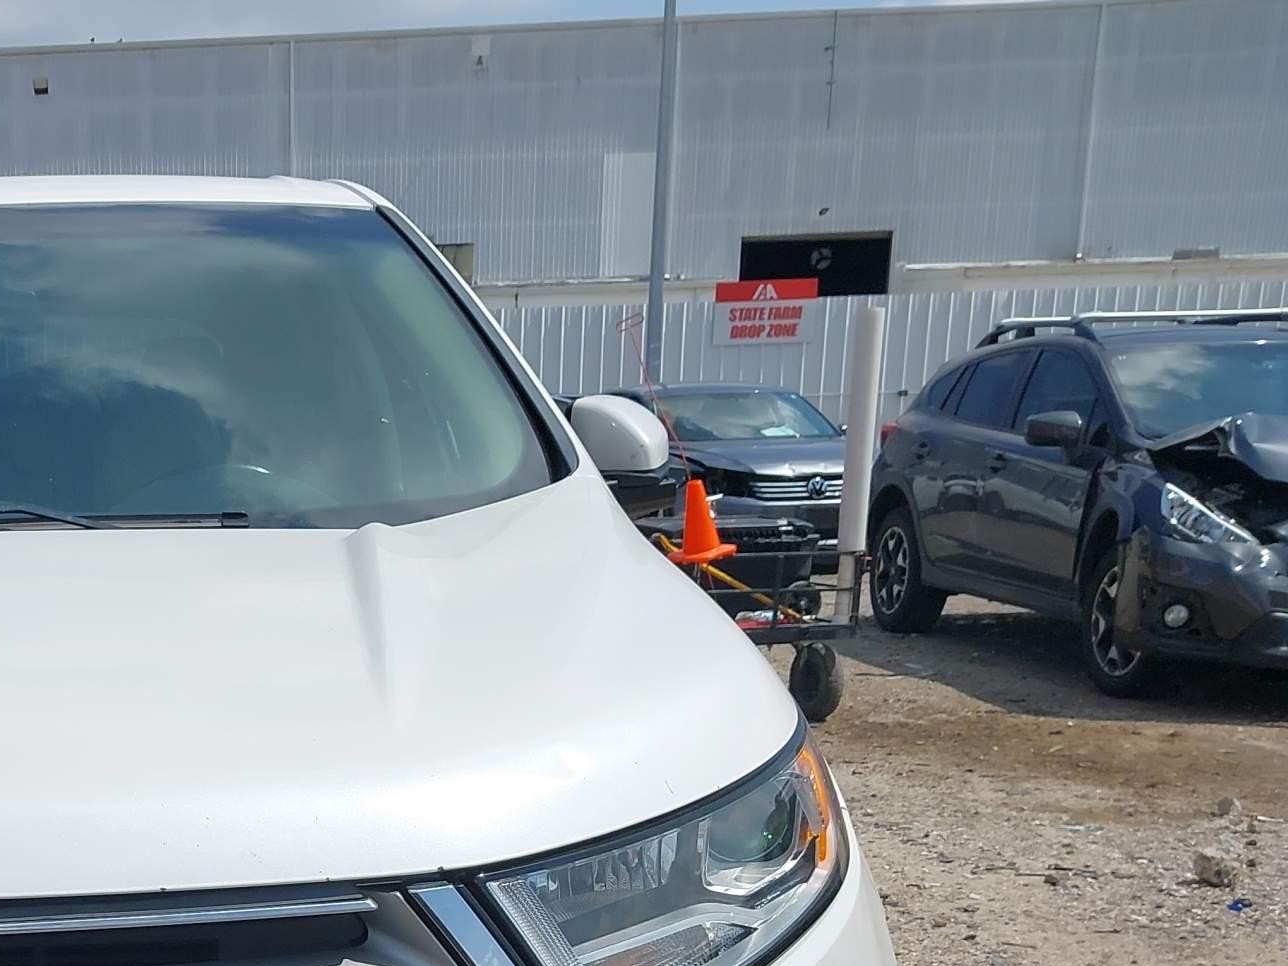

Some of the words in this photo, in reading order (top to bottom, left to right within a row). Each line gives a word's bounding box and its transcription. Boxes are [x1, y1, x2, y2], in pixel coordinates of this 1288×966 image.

[728, 307, 767, 322] STATE
[768, 305, 803, 320] FARM
[730, 324, 766, 339] DROP
[767, 323, 799, 338] ZONE
